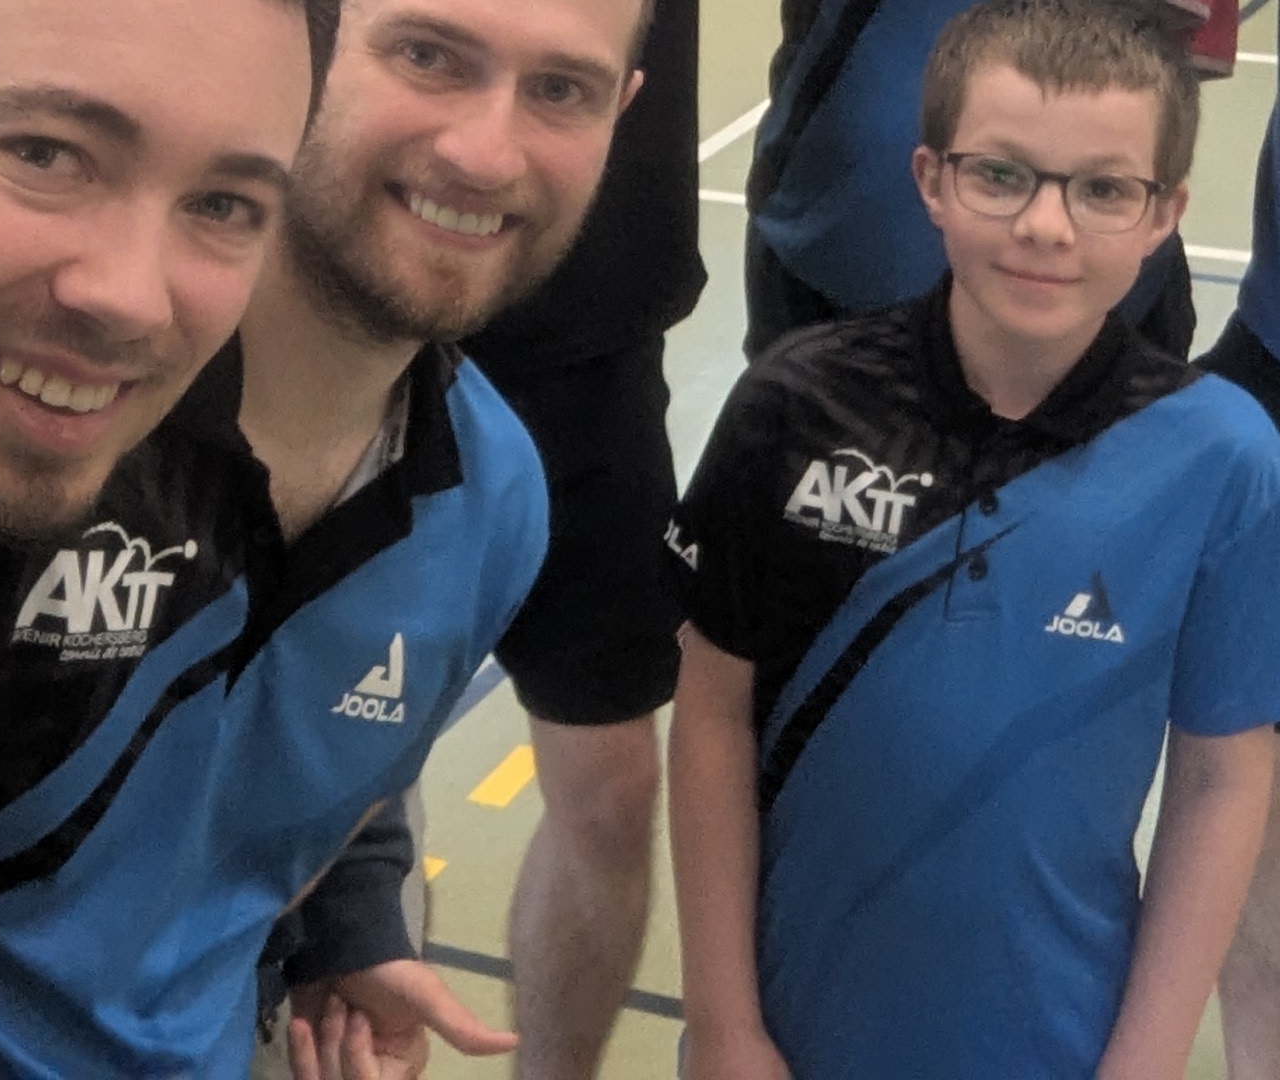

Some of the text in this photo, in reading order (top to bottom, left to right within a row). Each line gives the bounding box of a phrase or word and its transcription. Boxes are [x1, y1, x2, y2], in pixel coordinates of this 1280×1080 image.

[663, 518, 697, 570] LA
[1045, 616, 1124, 643] JOOLA
[330, 692, 405, 723] JOOLA
